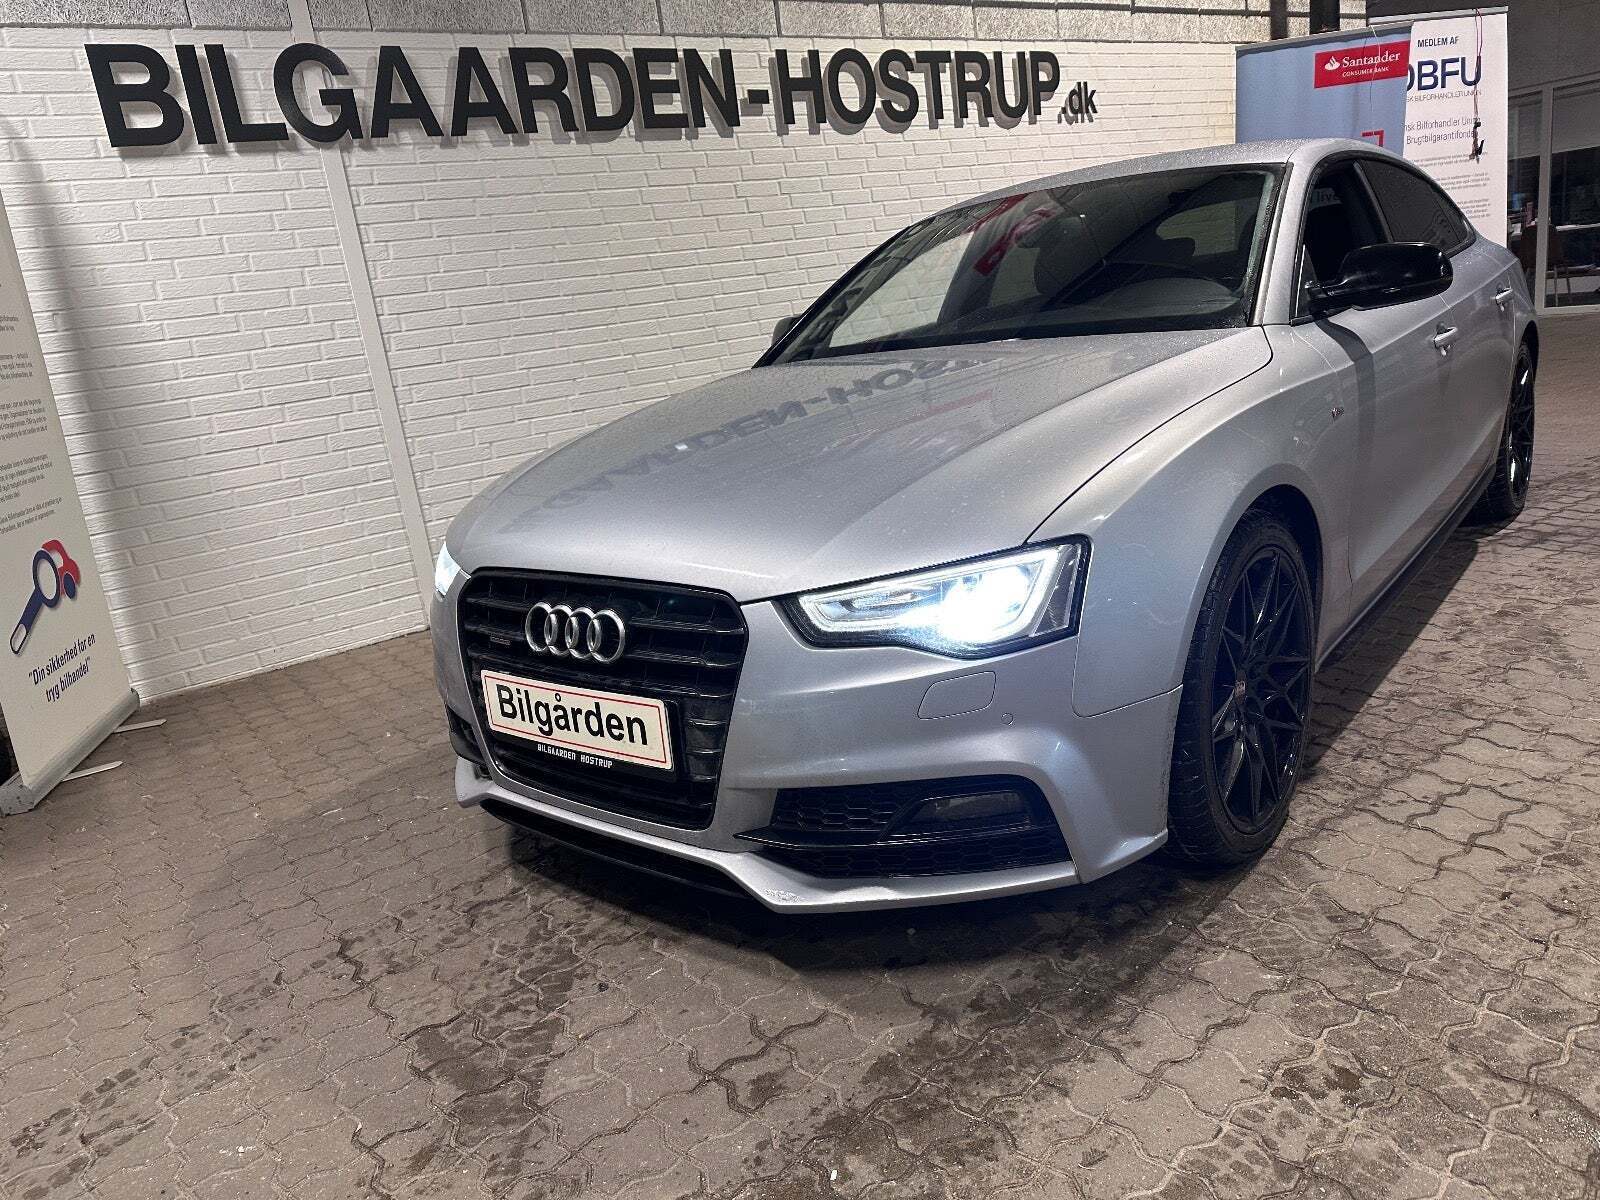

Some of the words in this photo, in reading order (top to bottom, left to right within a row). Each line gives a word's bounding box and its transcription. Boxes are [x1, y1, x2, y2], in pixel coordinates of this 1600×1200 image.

[1417, 37, 1448, 47] MEDLEM
[1449, 36, 1460, 45] AF
[1342, 50, 1401, 68] Santander
[1342, 68, 1373, 77] CONSUMER
[1416, 118, 1460, 131] Bilforhandler
[1406, 130, 1478, 146] Brugtbilgarantifonde
[28, 668, 46, 685] "Din
[46, 642, 78, 676] sikkerhed
[77, 637, 87, 654] for
[87, 633, 96, 647] en
[45, 684, 60, 702] tryg
[59, 656, 91, 692] bilhandel"
[495, 683, 648, 745] Bilgården
[537, 743, 576, 761] BILGAARDEN
[580, 754, 613, 769] HOSTRUP
